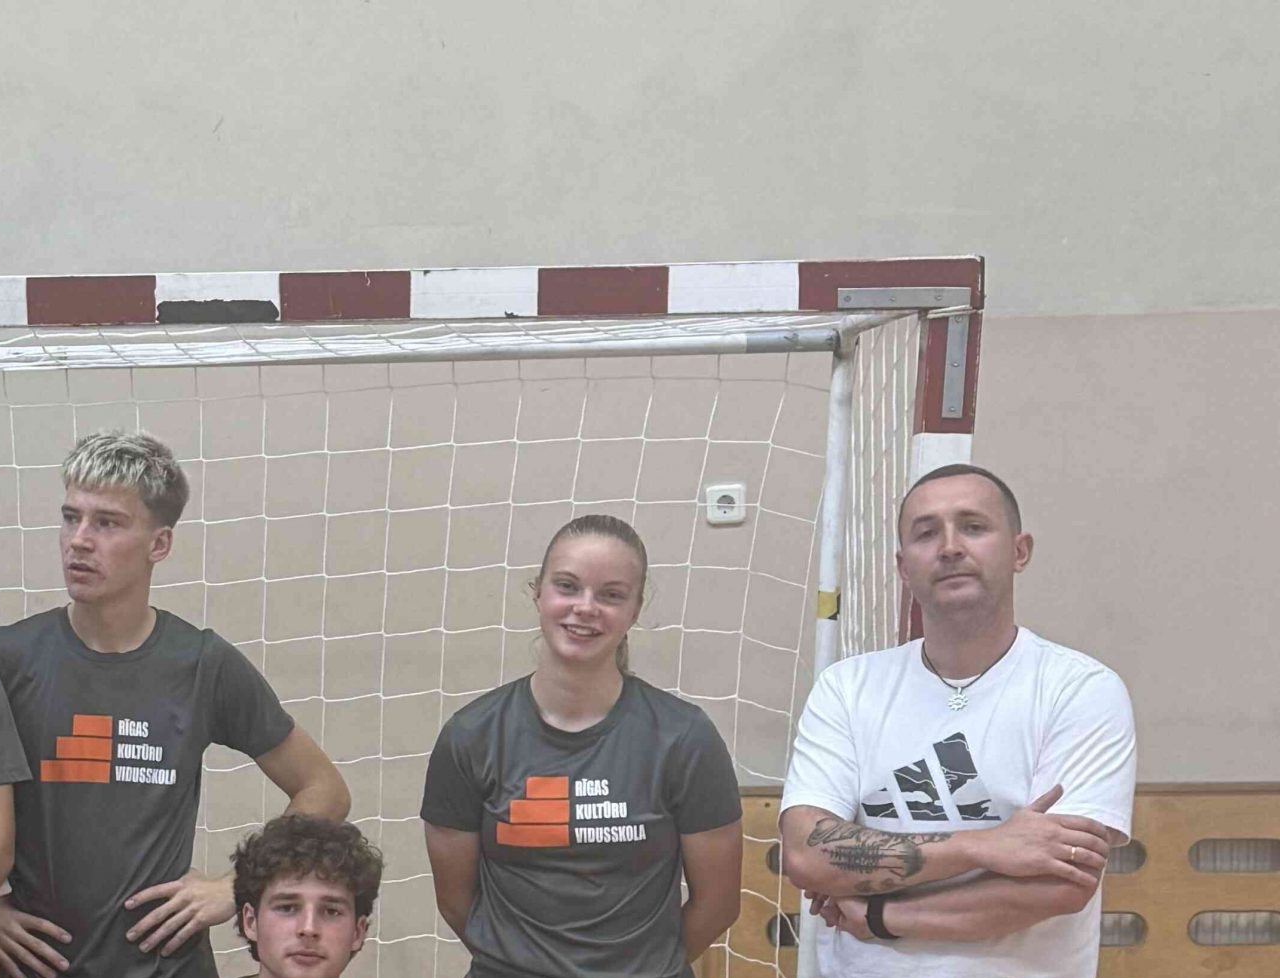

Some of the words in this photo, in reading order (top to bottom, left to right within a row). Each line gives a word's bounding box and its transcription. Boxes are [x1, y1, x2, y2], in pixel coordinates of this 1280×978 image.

[118, 718, 149, 738] RĪGAS
[115, 765, 177, 785] VIDUSSKOLA
[575, 778, 609, 797] RĪGAS
[575, 801, 628, 820] KULTŪRU
[574, 824, 646, 844] VIDUSSKOLA
